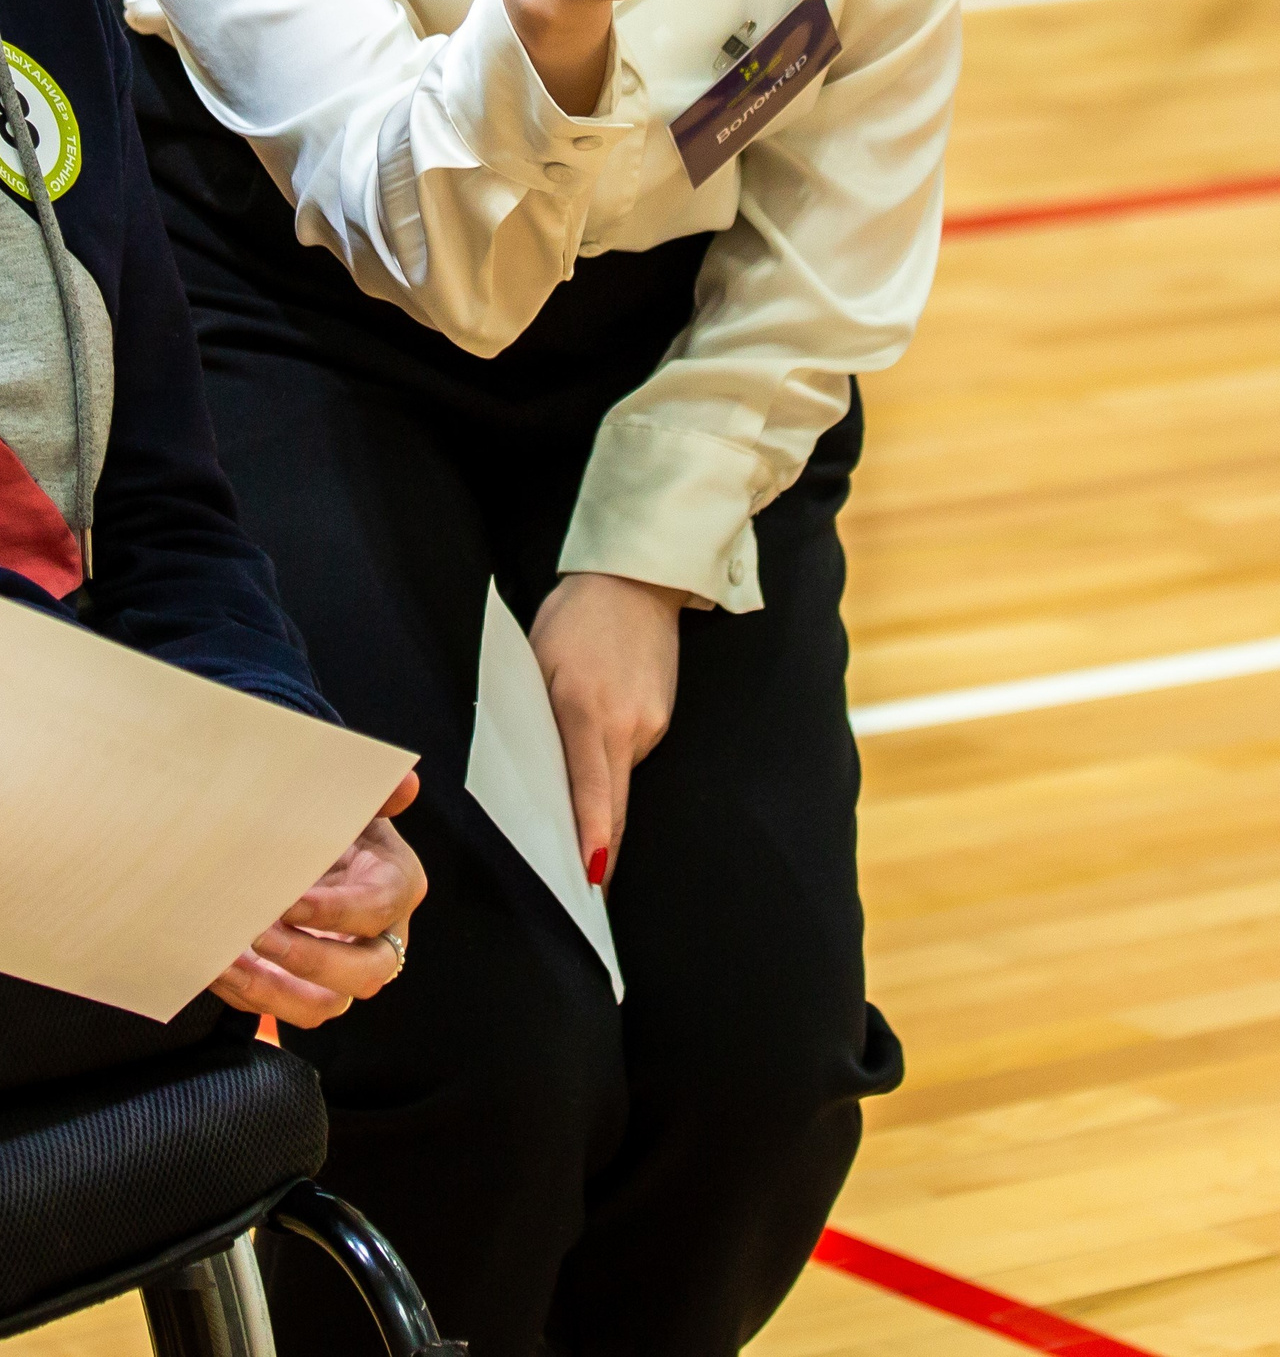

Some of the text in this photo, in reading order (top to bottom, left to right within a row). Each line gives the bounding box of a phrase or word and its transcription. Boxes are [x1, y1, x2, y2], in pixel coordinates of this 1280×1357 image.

[3, 45, 69, 121] ДЫХАНИЕ»
[50, 134, 77, 193] ТЕННИС
[716, 54, 808, 145] Волонтёр
